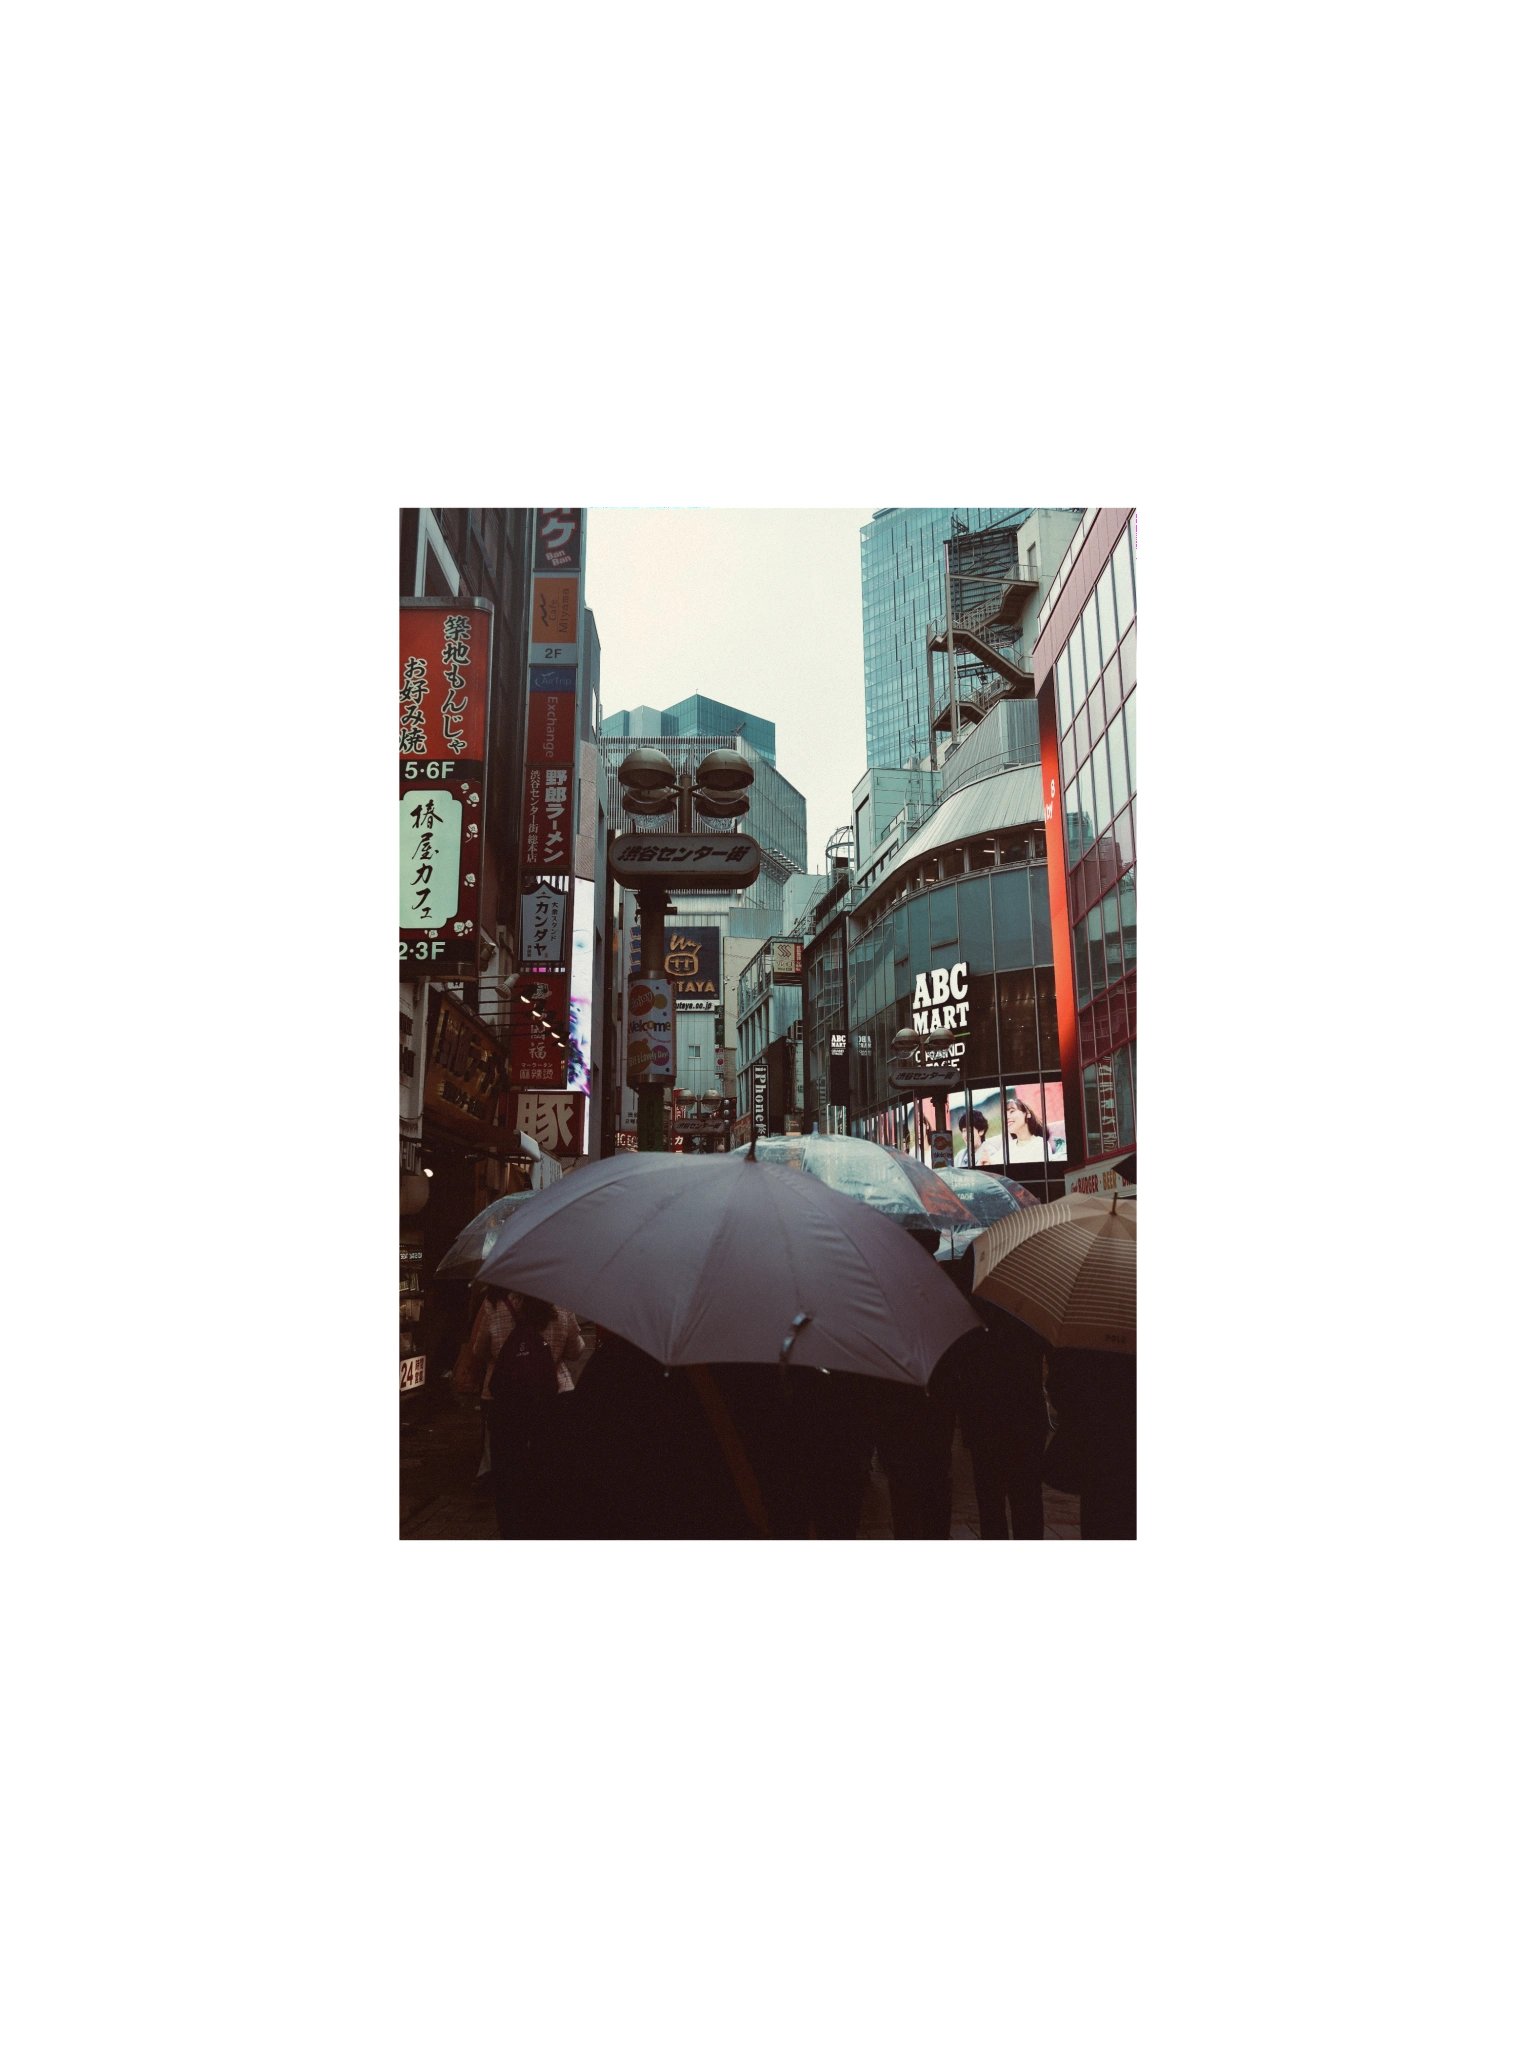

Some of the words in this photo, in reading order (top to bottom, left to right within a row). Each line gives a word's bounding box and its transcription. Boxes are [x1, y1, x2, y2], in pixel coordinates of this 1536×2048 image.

[545, 550, 566, 560] Ban
[551, 556, 572, 566] Ban
[544, 648, 562, 659] 2F
[399, 656, 429, 755] お好み焼
[442, 615, 472, 755] 築地もんじゃ
[543, 696, 558, 758] Exchange
[544, 769, 568, 863] 野郎ラーメン
[410, 799, 444, 919] 椿屋カフェ
[617, 845, 751, 863] 渋谷センター街
[533, 901, 549, 957] カンダヤ
[676, 981, 716, 993] TAYA
[912, 962, 969, 1010] ABC
[912, 1002, 970, 1036] MART
[516, 1094, 574, 1151] 豚
[1078, 1174, 1099, 1194] BURGER
[1103, 1169, 1117, 1190] BEER
[401, 1361, 413, 1388] 24
